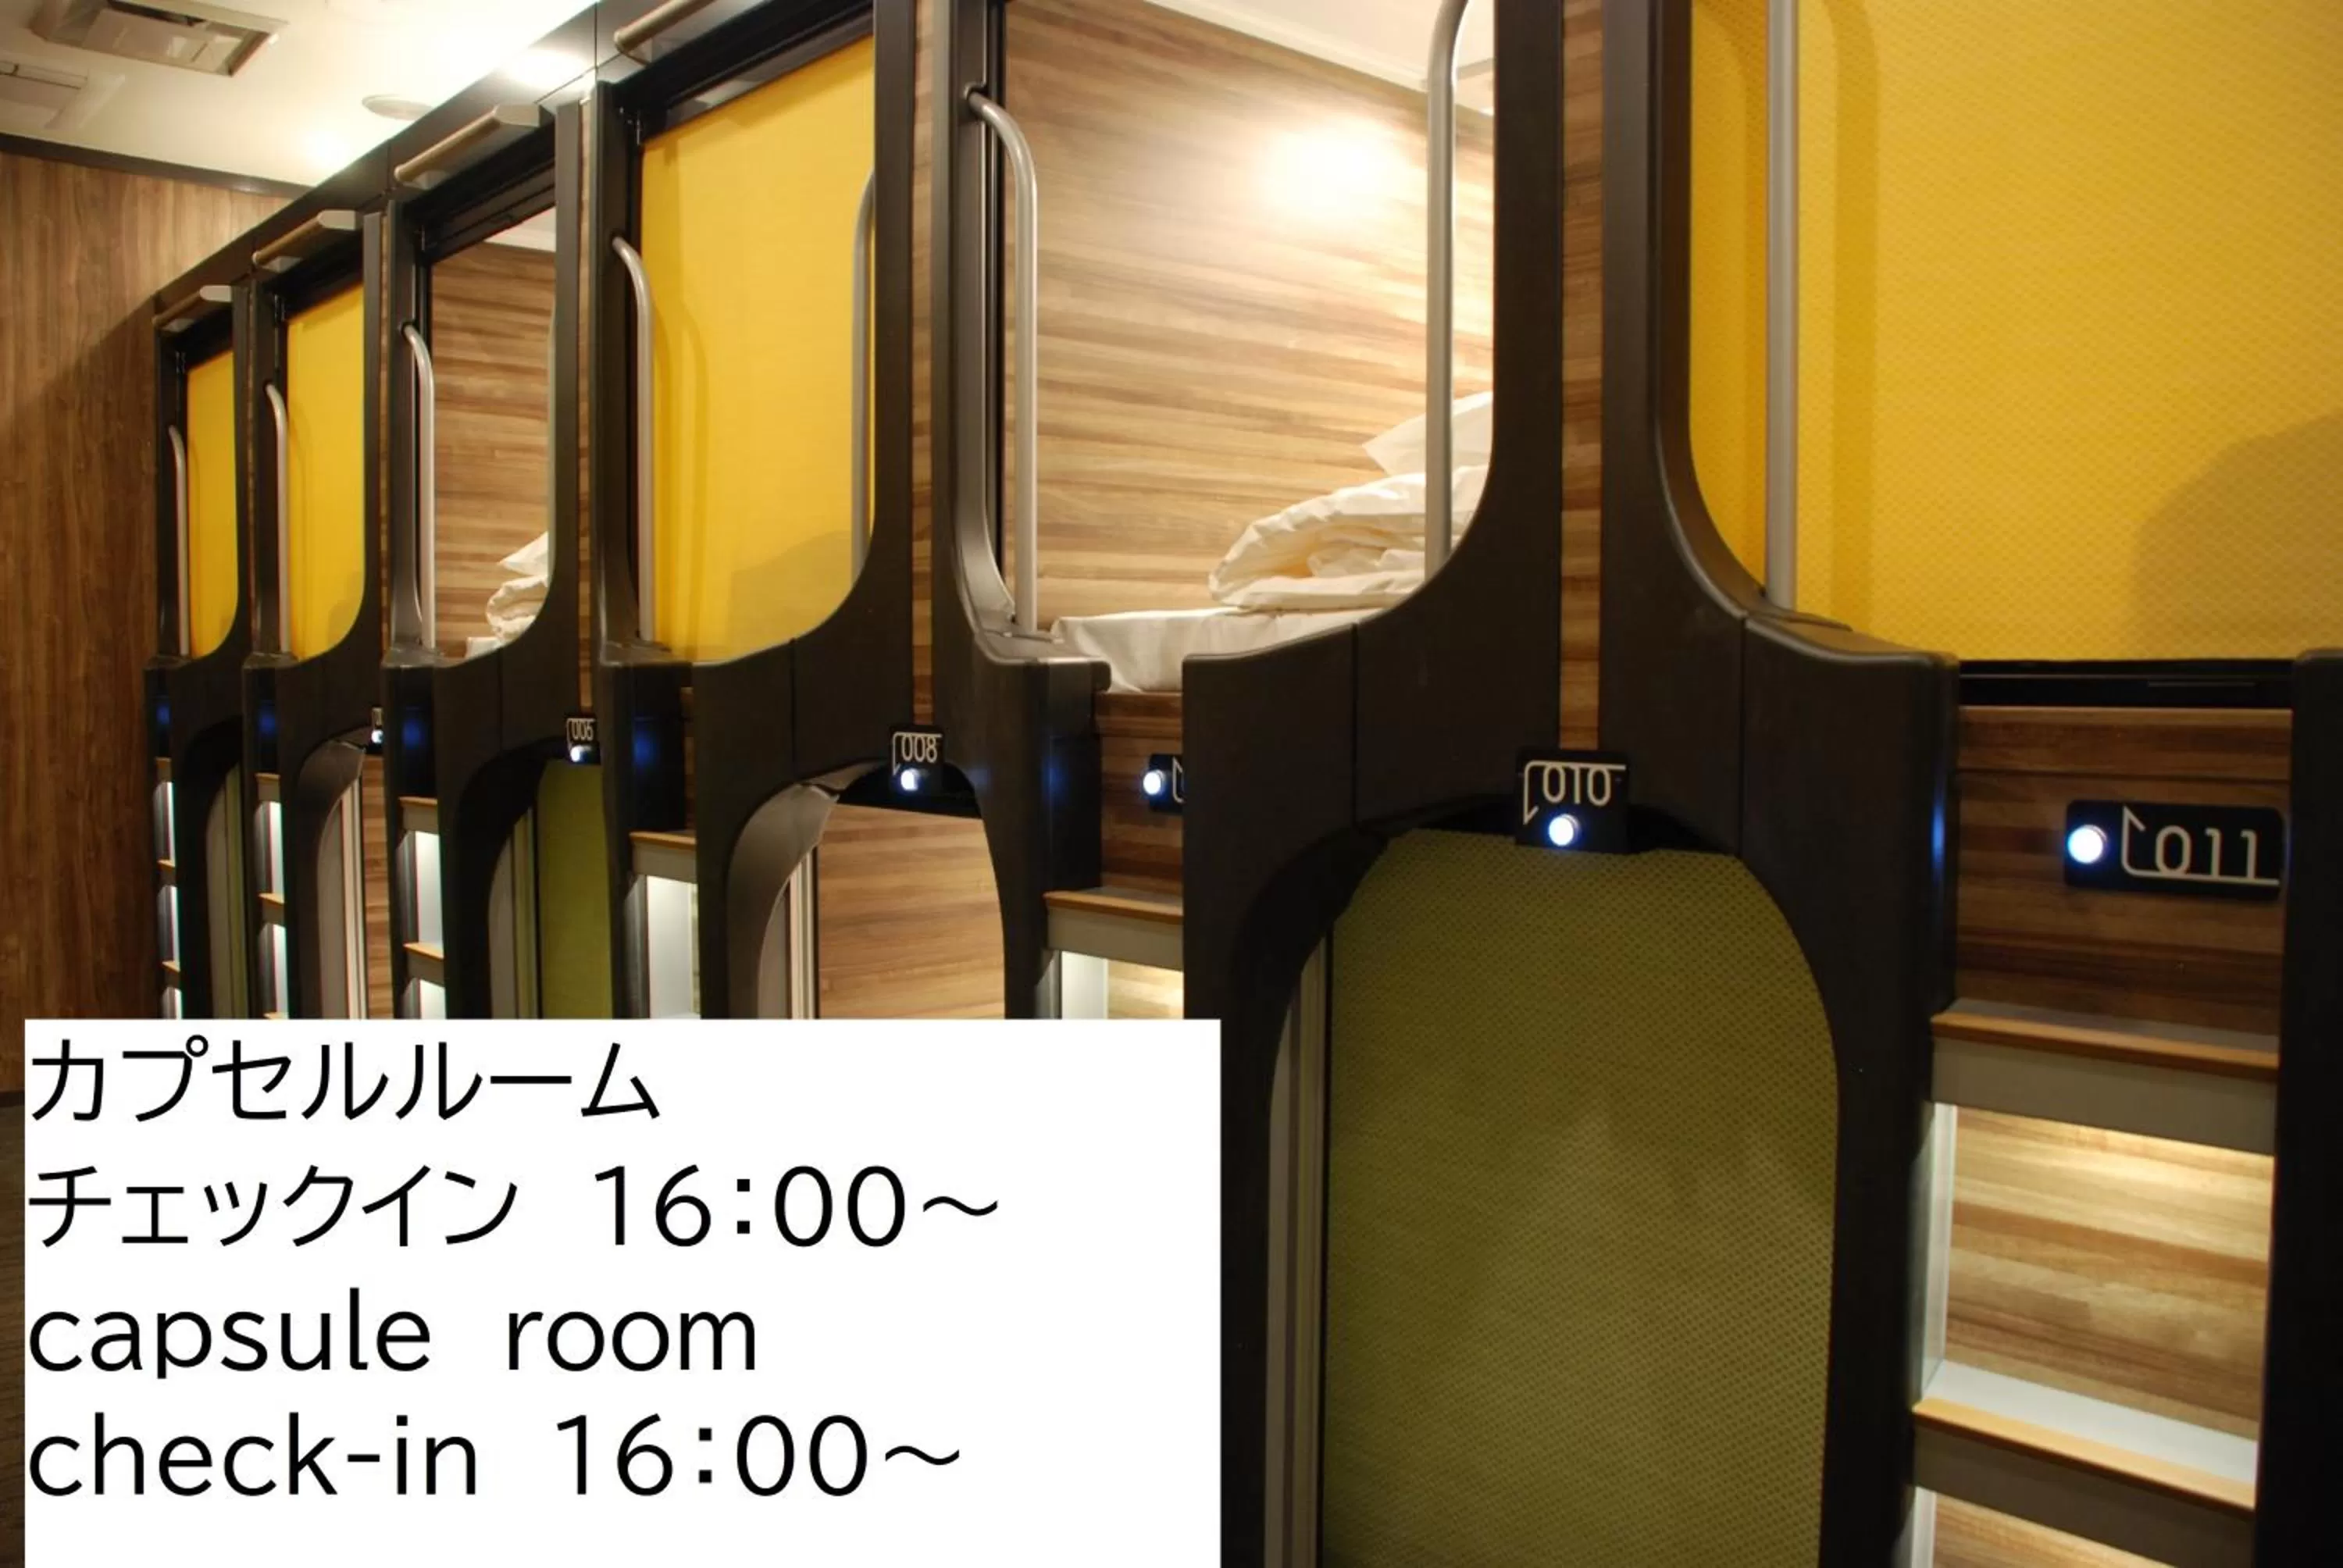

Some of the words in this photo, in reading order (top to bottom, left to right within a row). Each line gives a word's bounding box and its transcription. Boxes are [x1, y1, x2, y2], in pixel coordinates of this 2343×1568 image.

[901, 732, 938, 764] 008
[1542, 762, 1611, 807] 010
[2155, 825, 2258, 881] 011
